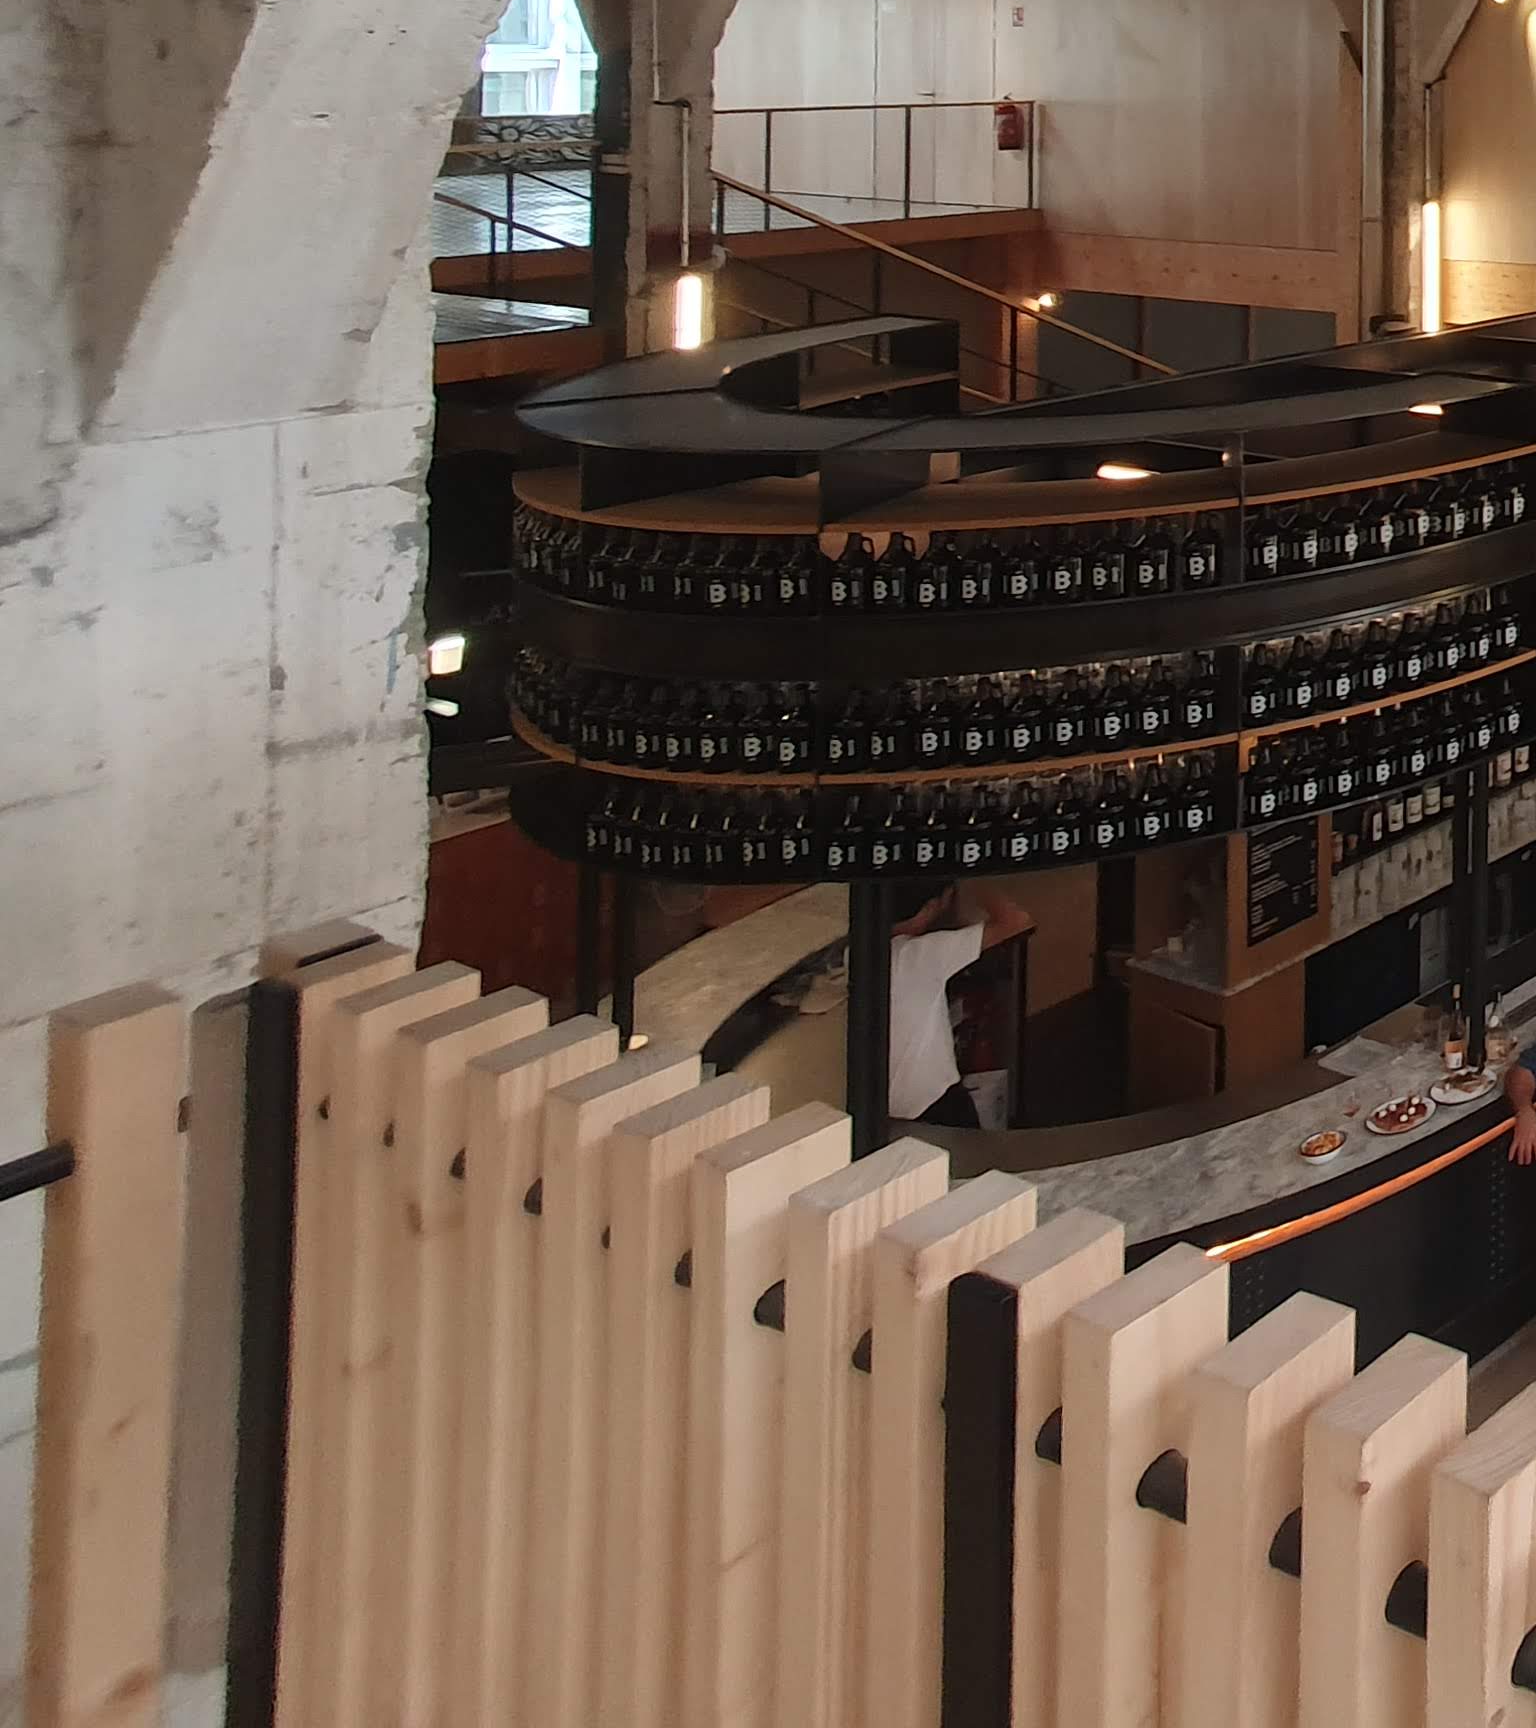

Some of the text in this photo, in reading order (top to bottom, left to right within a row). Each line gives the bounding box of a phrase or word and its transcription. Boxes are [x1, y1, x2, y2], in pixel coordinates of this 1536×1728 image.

[1482, 505, 1495, 525] B
[1512, 495, 1525, 516] B
[1417, 515, 1430, 535] B
[1454, 512, 1466, 532] B
[1344, 531, 1359, 554] B
[1380, 524, 1394, 545] B
[1262, 545, 1278, 566] B
[1302, 539, 1318, 560] B
[1093, 566, 1107, 587] B
[1139, 563, 1154, 584] B
[1189, 555, 1205, 577] B
[780, 578, 794, 599] B
[874, 579, 887, 601] B
[962, 578, 977, 600] B
[1011, 574, 1028, 596] B
[1055, 569, 1071, 591] B
[710, 583, 726, 604] B
[832, 581, 847, 602] B
[919, 582, 936, 604] B
[1505, 624, 1518, 646] B
[1446, 646, 1460, 667] B
[1478, 636, 1490, 658] B
[1372, 666, 1387, 687] B
[1407, 657, 1422, 678] B
[1297, 684, 1312, 706] B
[1336, 676, 1351, 698] B
[1187, 703, 1203, 725] B
[1250, 694, 1267, 715] B
[1103, 715, 1121, 737] B
[1143, 710, 1159, 731] B
[1508, 712, 1520, 733] B
[922, 731, 938, 753] B
[966, 730, 983, 752] B
[1013, 727, 1030, 749] B
[1057, 721, 1073, 743] B
[1478, 727, 1491, 748] B
[667, 737, 679, 758] B
[701, 738, 715, 759] B
[744, 736, 761, 758] B
[780, 741, 796, 762] B
[830, 738, 843, 760] B
[1446, 740, 1460, 762] B
[1376, 762, 1391, 783] B
[1411, 752, 1425, 774] B
[1303, 780, 1318, 803] B
[1338, 772, 1353, 794] B
[1260, 792, 1276, 815] B
[1143, 815, 1161, 837] B
[1187, 807, 1204, 829] B
[1052, 830, 1069, 852] B
[1097, 823, 1114, 845] B
[783, 839, 796, 860] B
[829, 845, 843, 867] B
[873, 844, 888, 866] B
[917, 842, 933, 864] B
[962, 841, 981, 864] B
[1011, 836, 1029, 858] B
